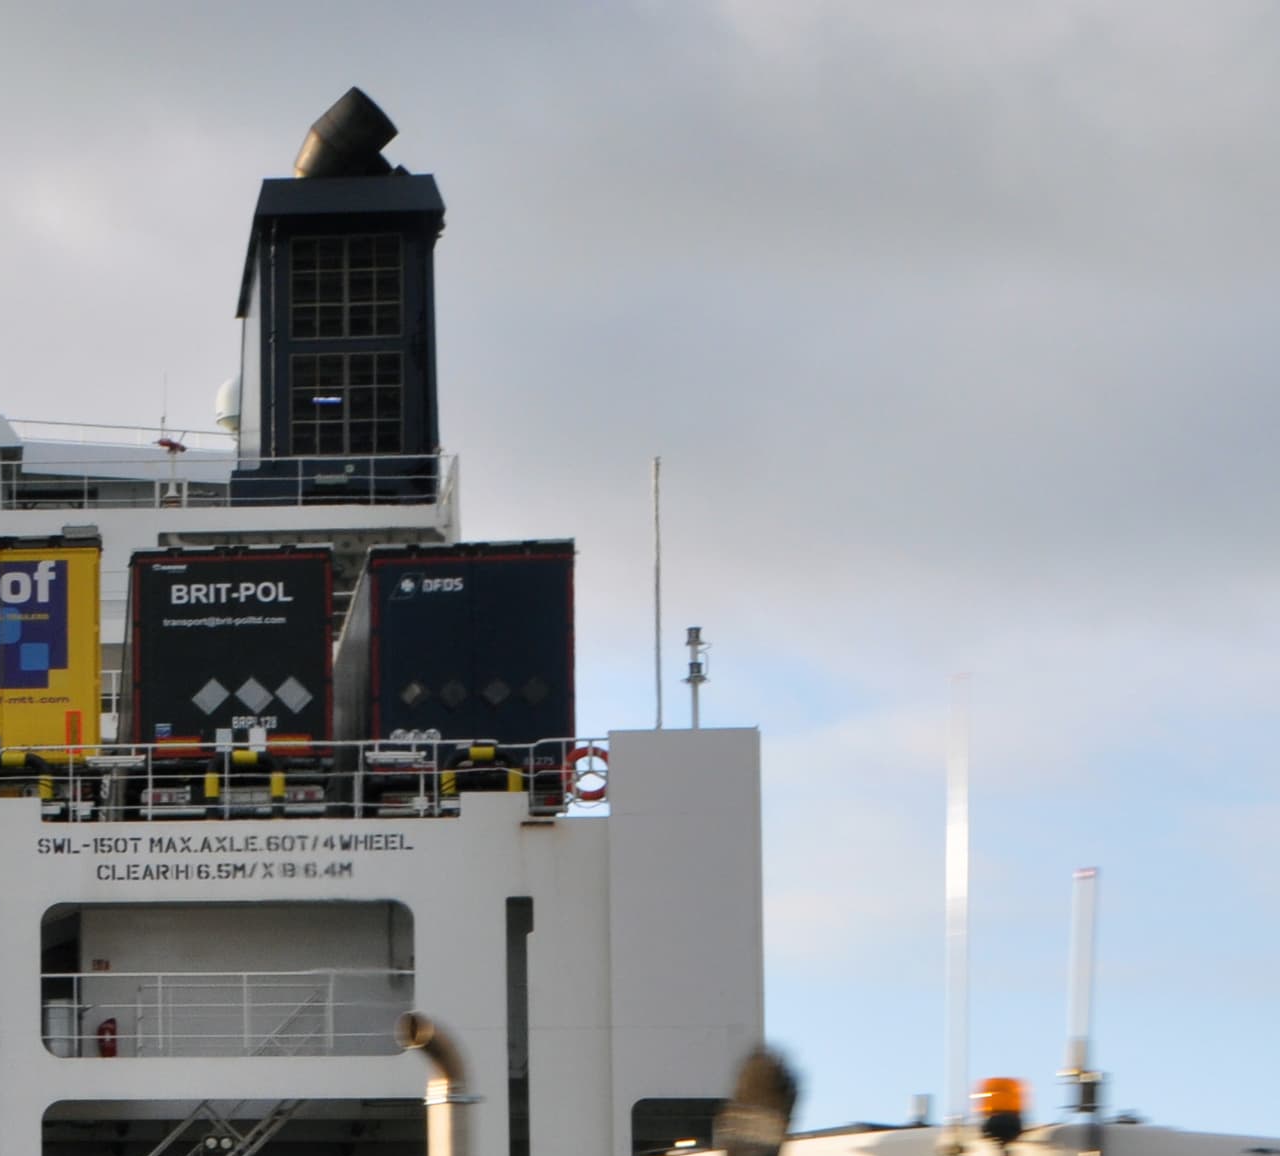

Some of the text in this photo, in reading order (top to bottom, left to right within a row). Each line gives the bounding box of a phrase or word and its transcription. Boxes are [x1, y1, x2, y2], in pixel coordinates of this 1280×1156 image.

[171, 582, 294, 604] BRIT-POL
[422, 577, 464, 592] DFDS
[37, 837, 142, 854] SWL-150T
